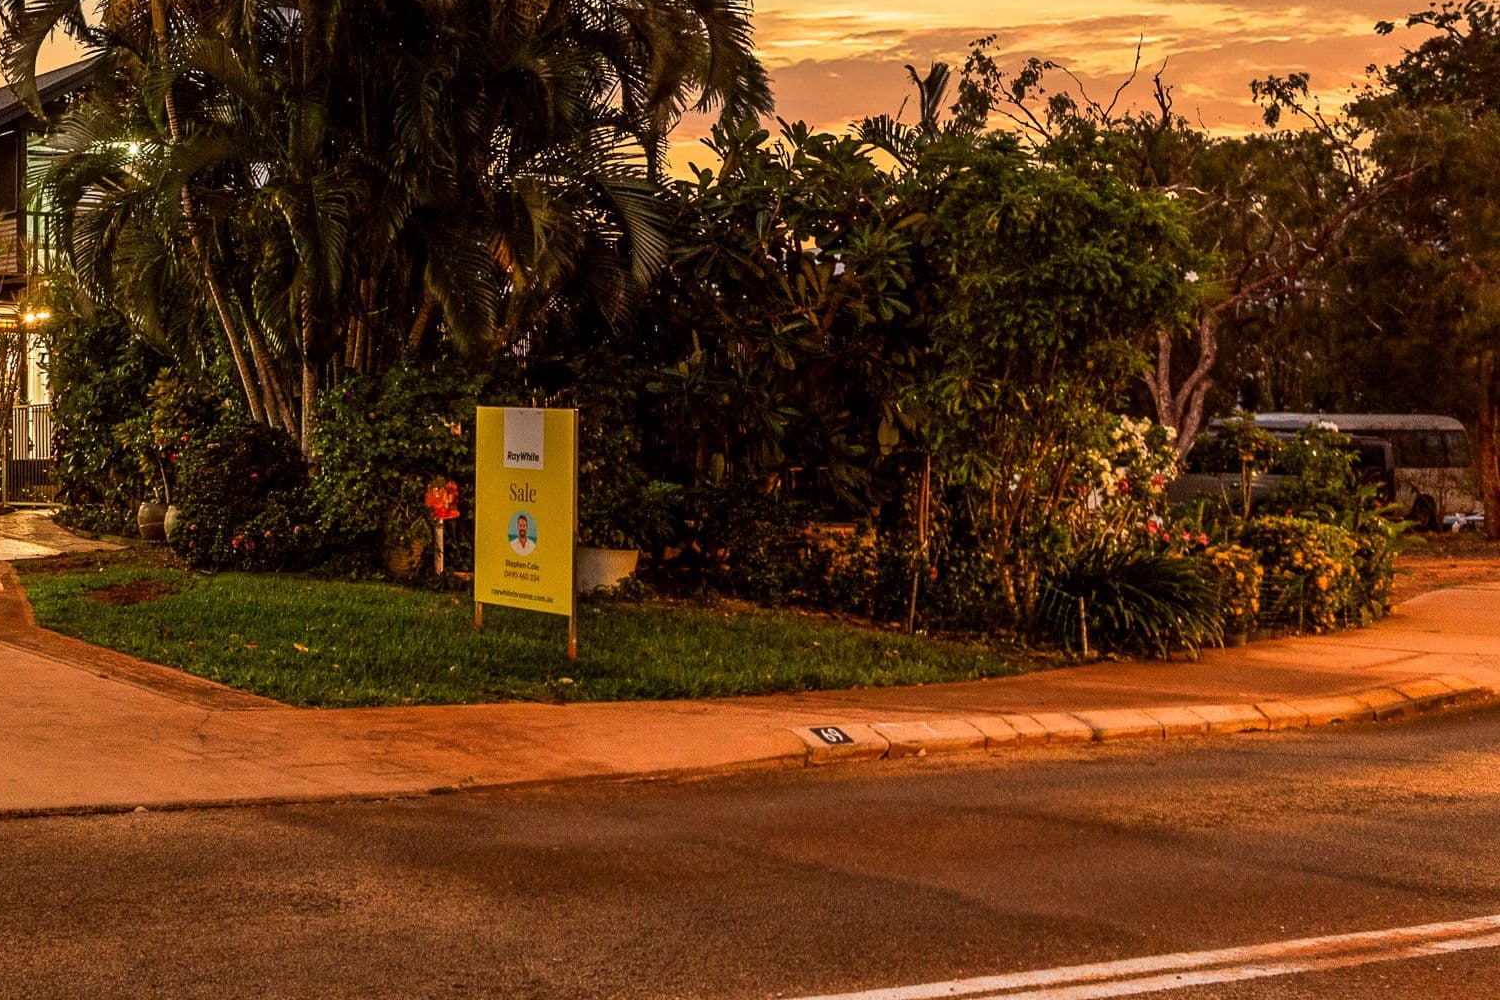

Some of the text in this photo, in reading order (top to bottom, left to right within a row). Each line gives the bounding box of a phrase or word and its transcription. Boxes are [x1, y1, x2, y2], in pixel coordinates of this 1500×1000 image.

[509, 482, 537, 503] Sale
[505, 559, 526, 569] Stephen
[820, 727, 843, 743] 69
